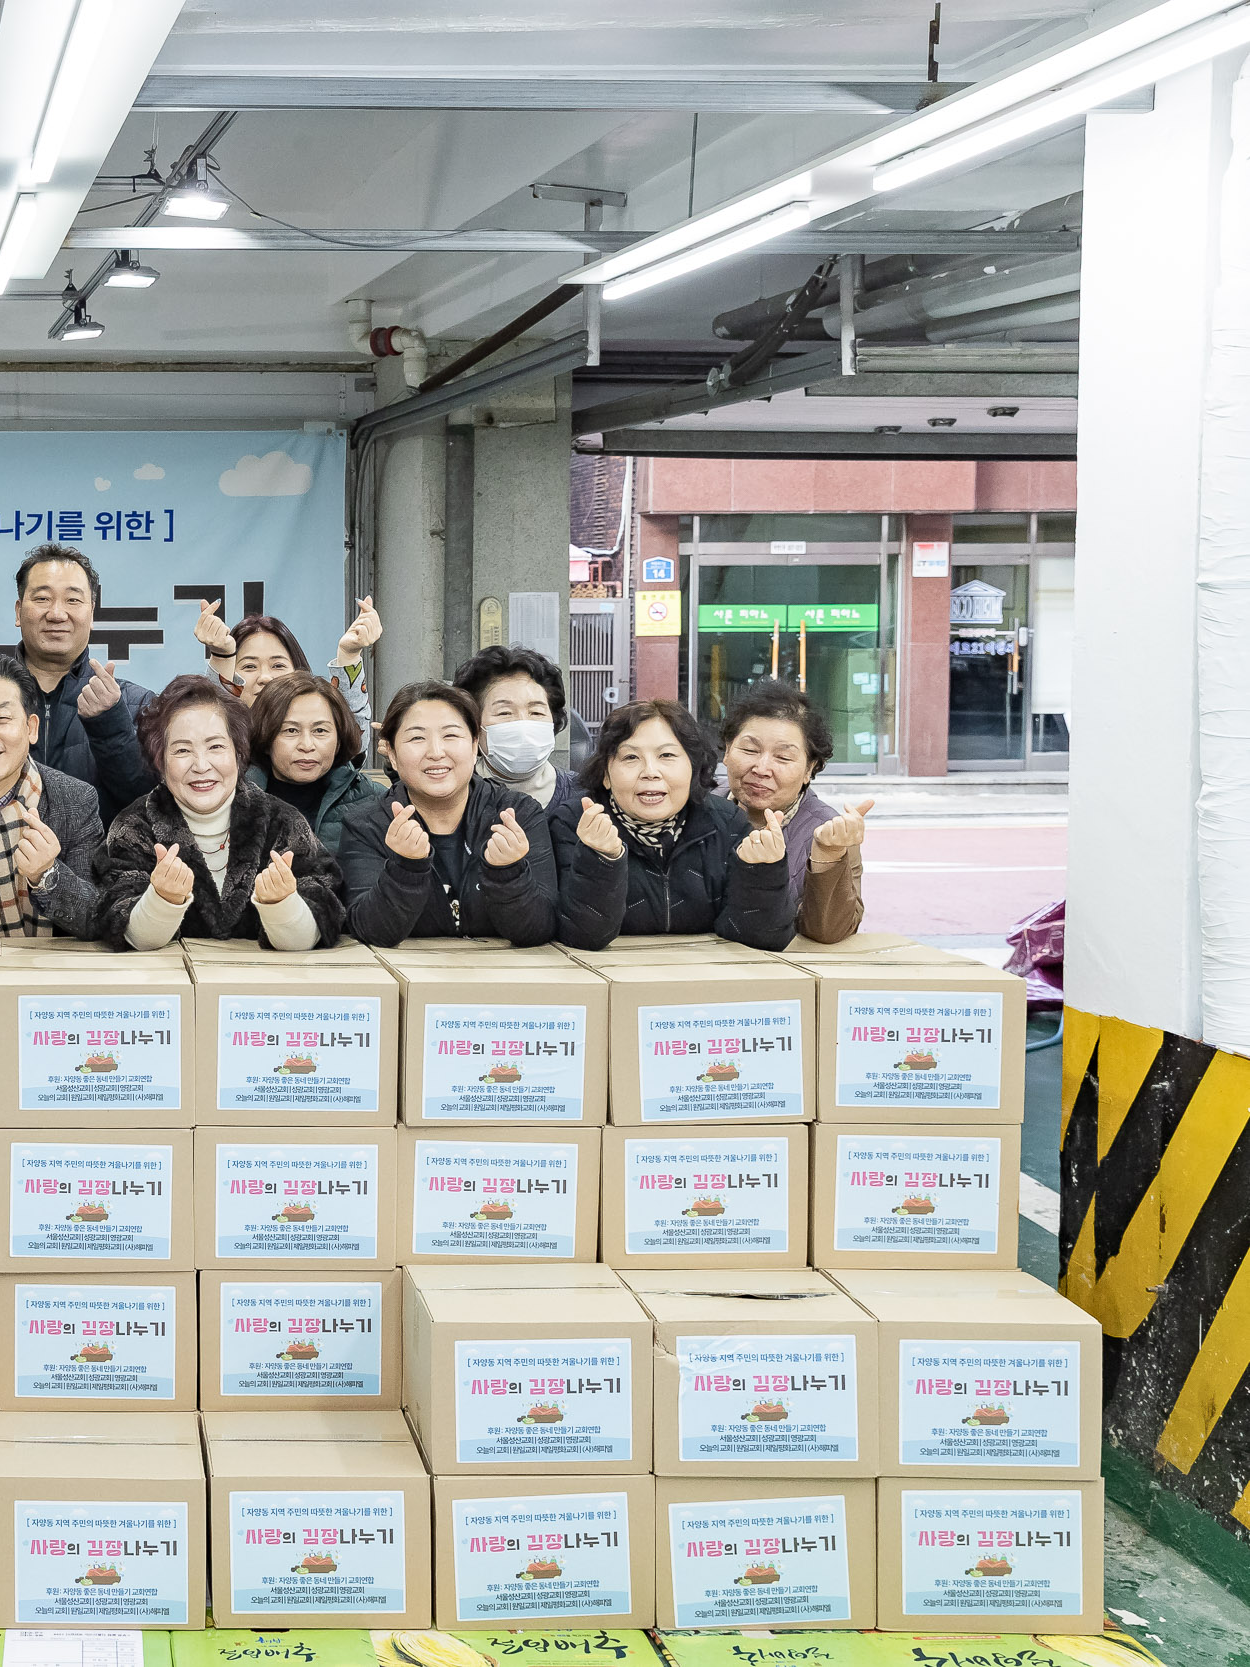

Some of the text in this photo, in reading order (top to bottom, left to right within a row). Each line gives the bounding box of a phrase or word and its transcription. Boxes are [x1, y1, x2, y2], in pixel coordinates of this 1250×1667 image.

[94, 509, 155, 542] 위한
[652, 569, 666, 579] 14
[33, 1028, 171, 1047] 사랑의 김장나누기
[852, 1026, 992, 1044] 사랑의 김장나누기
[438, 1040, 575, 1057] 사랑의 김장나누기
[653, 1034, 792, 1057] 사랑의 김장나누기
[25, 1179, 162, 1196] 사랑의 김장나누기
[230, 1179, 368, 1196] 사랑의 김장나누기
[639, 1171, 778, 1191] 사랑의 김장나누기
[850, 1171, 989, 1188] 사랑의 김장나누기
[234, 1317, 372, 1334] 사랑의 김장나누기
[471, 1376, 621, 1396] 사랑의 김장나누기
[693, 1373, 846, 1393] 사랑의 김장나누기
[915, 1378, 1069, 1397] 사랑의 김장나누기
[245, 1527, 394, 1546] 사랑의 김장나누기
[686, 1533, 836, 1559] 사랑의 김장나누기
[918, 1529, 1071, 1548] 사랑의 김장나누기
[30, 1539, 177, 1557] 사랑의 김장나누기
[219, 1641, 318, 1663] 절임배추
[487, 1632, 628, 1660] 절임배추
